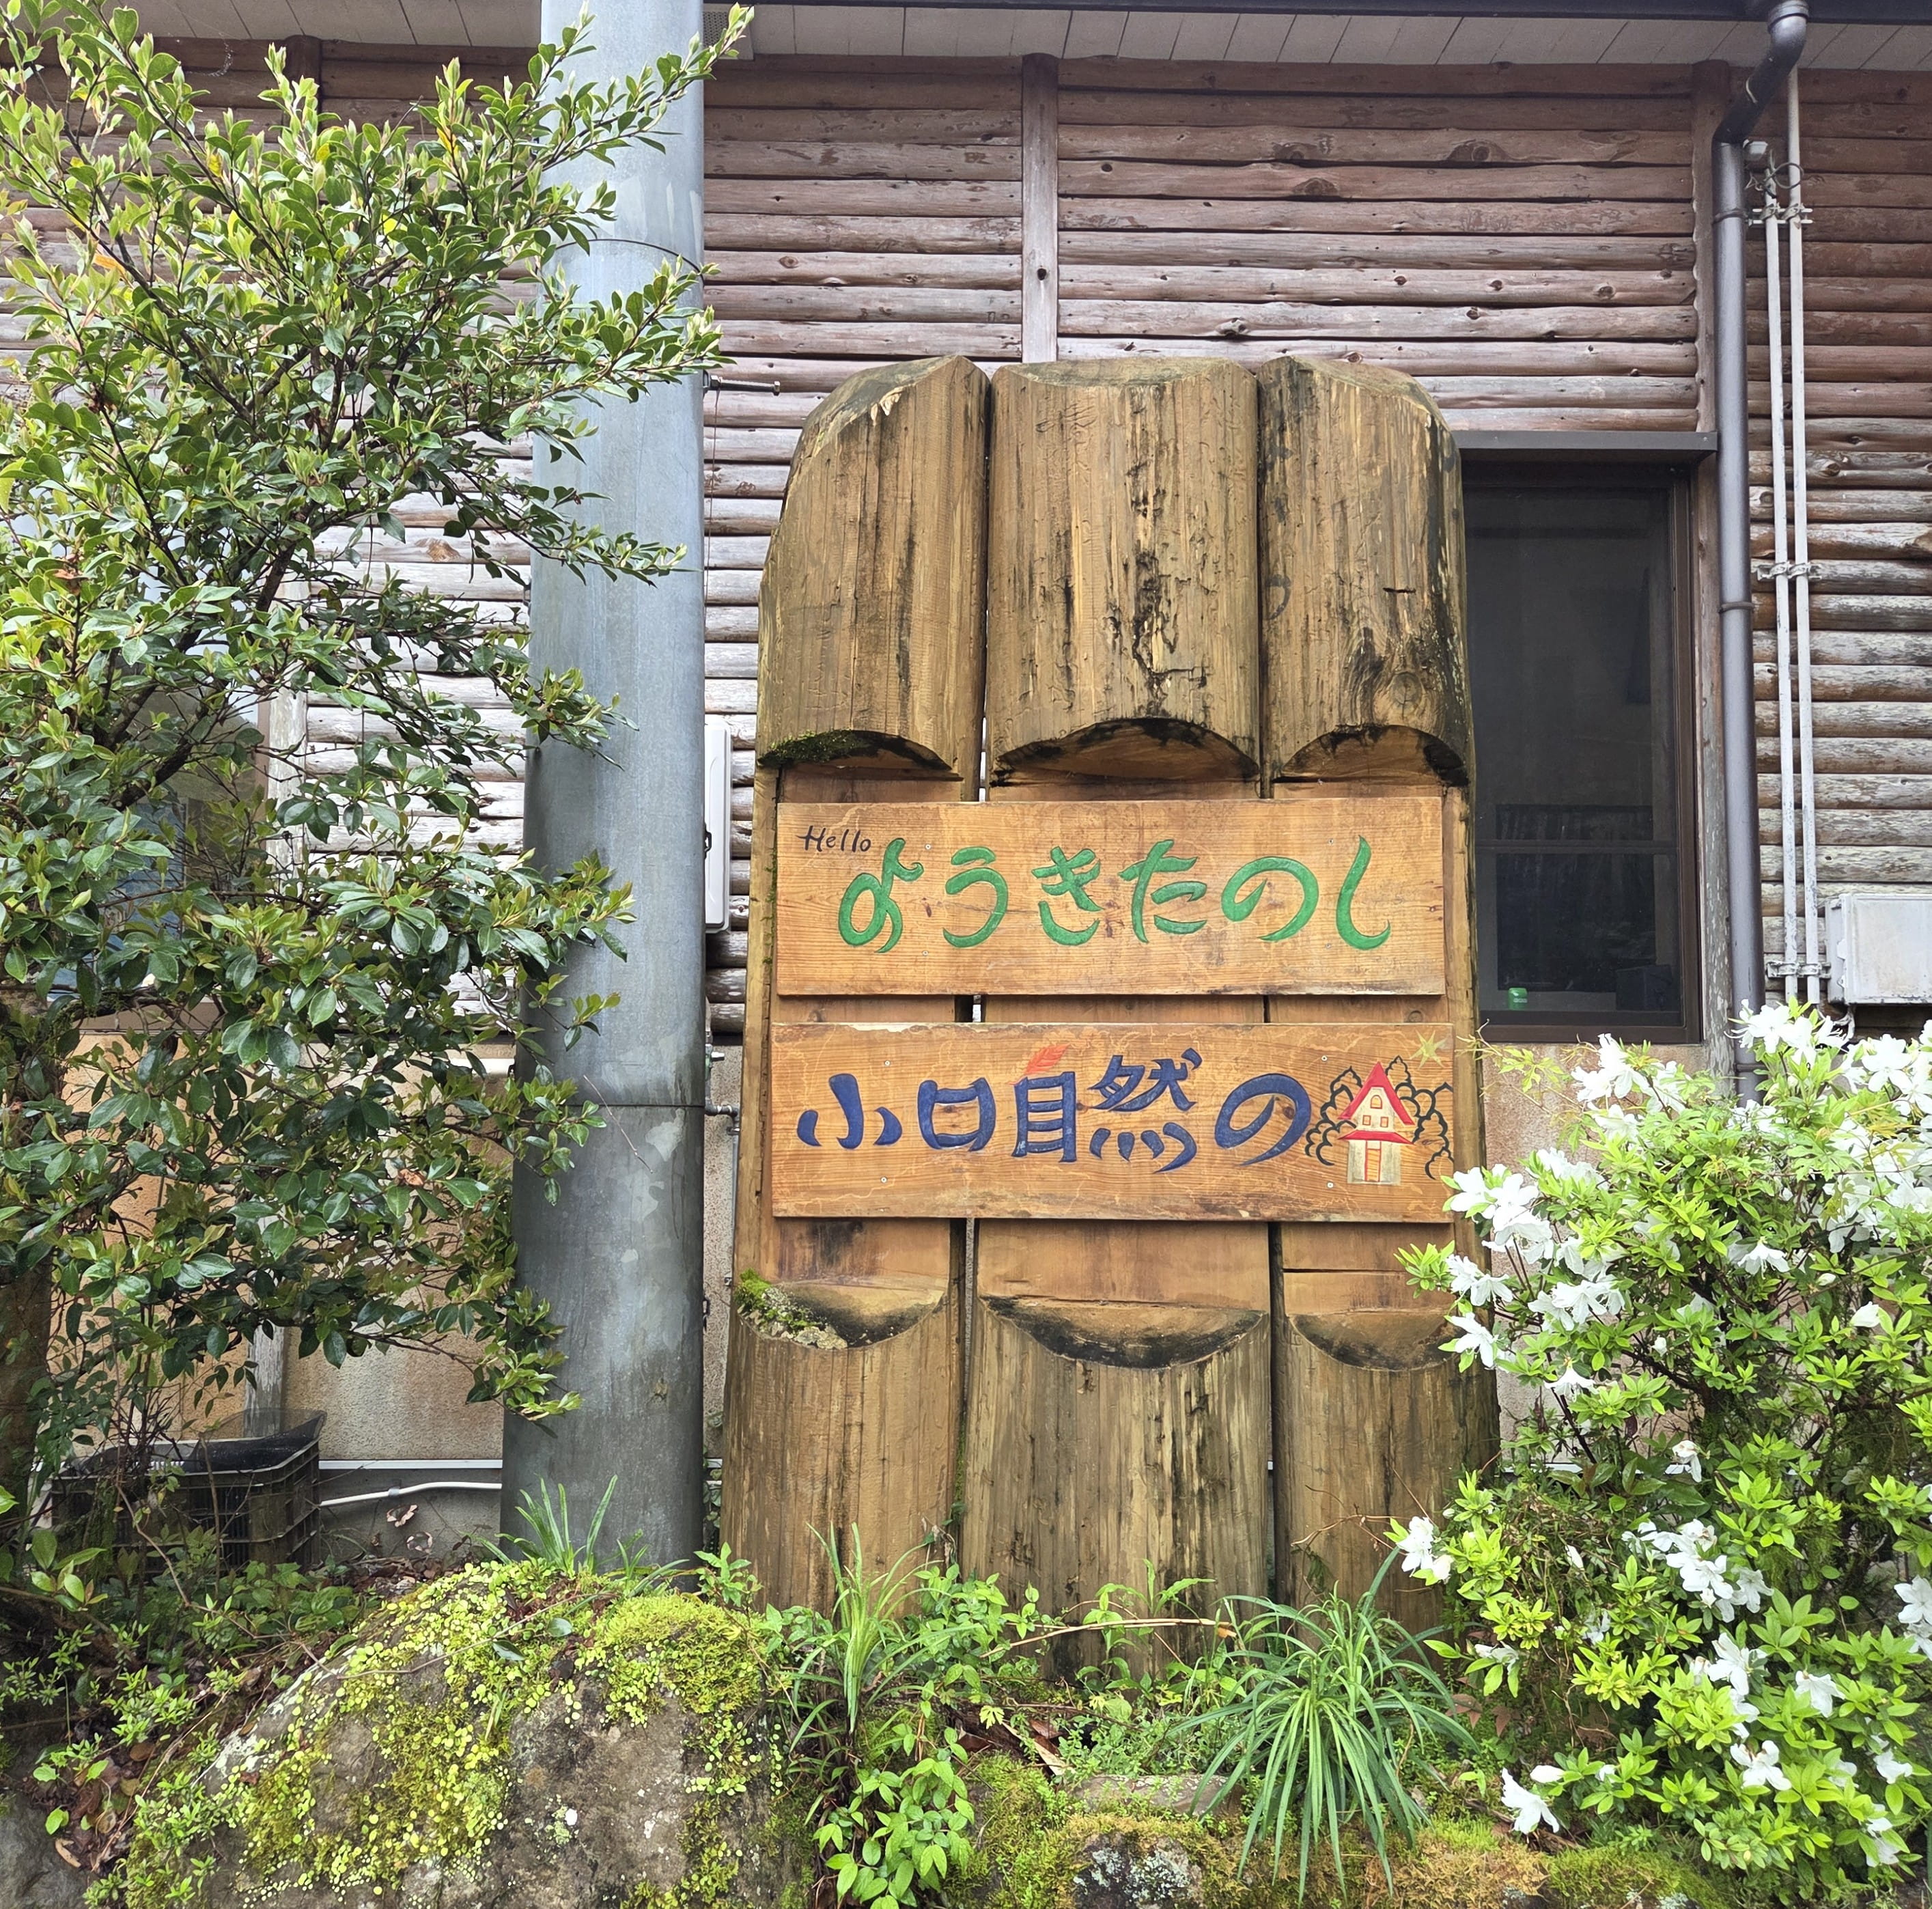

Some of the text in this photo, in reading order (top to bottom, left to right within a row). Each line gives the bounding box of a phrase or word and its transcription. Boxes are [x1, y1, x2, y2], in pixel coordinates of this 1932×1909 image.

[796, 825, 871, 853] Hello
[838, 835, 1391, 953] ようきたのし
